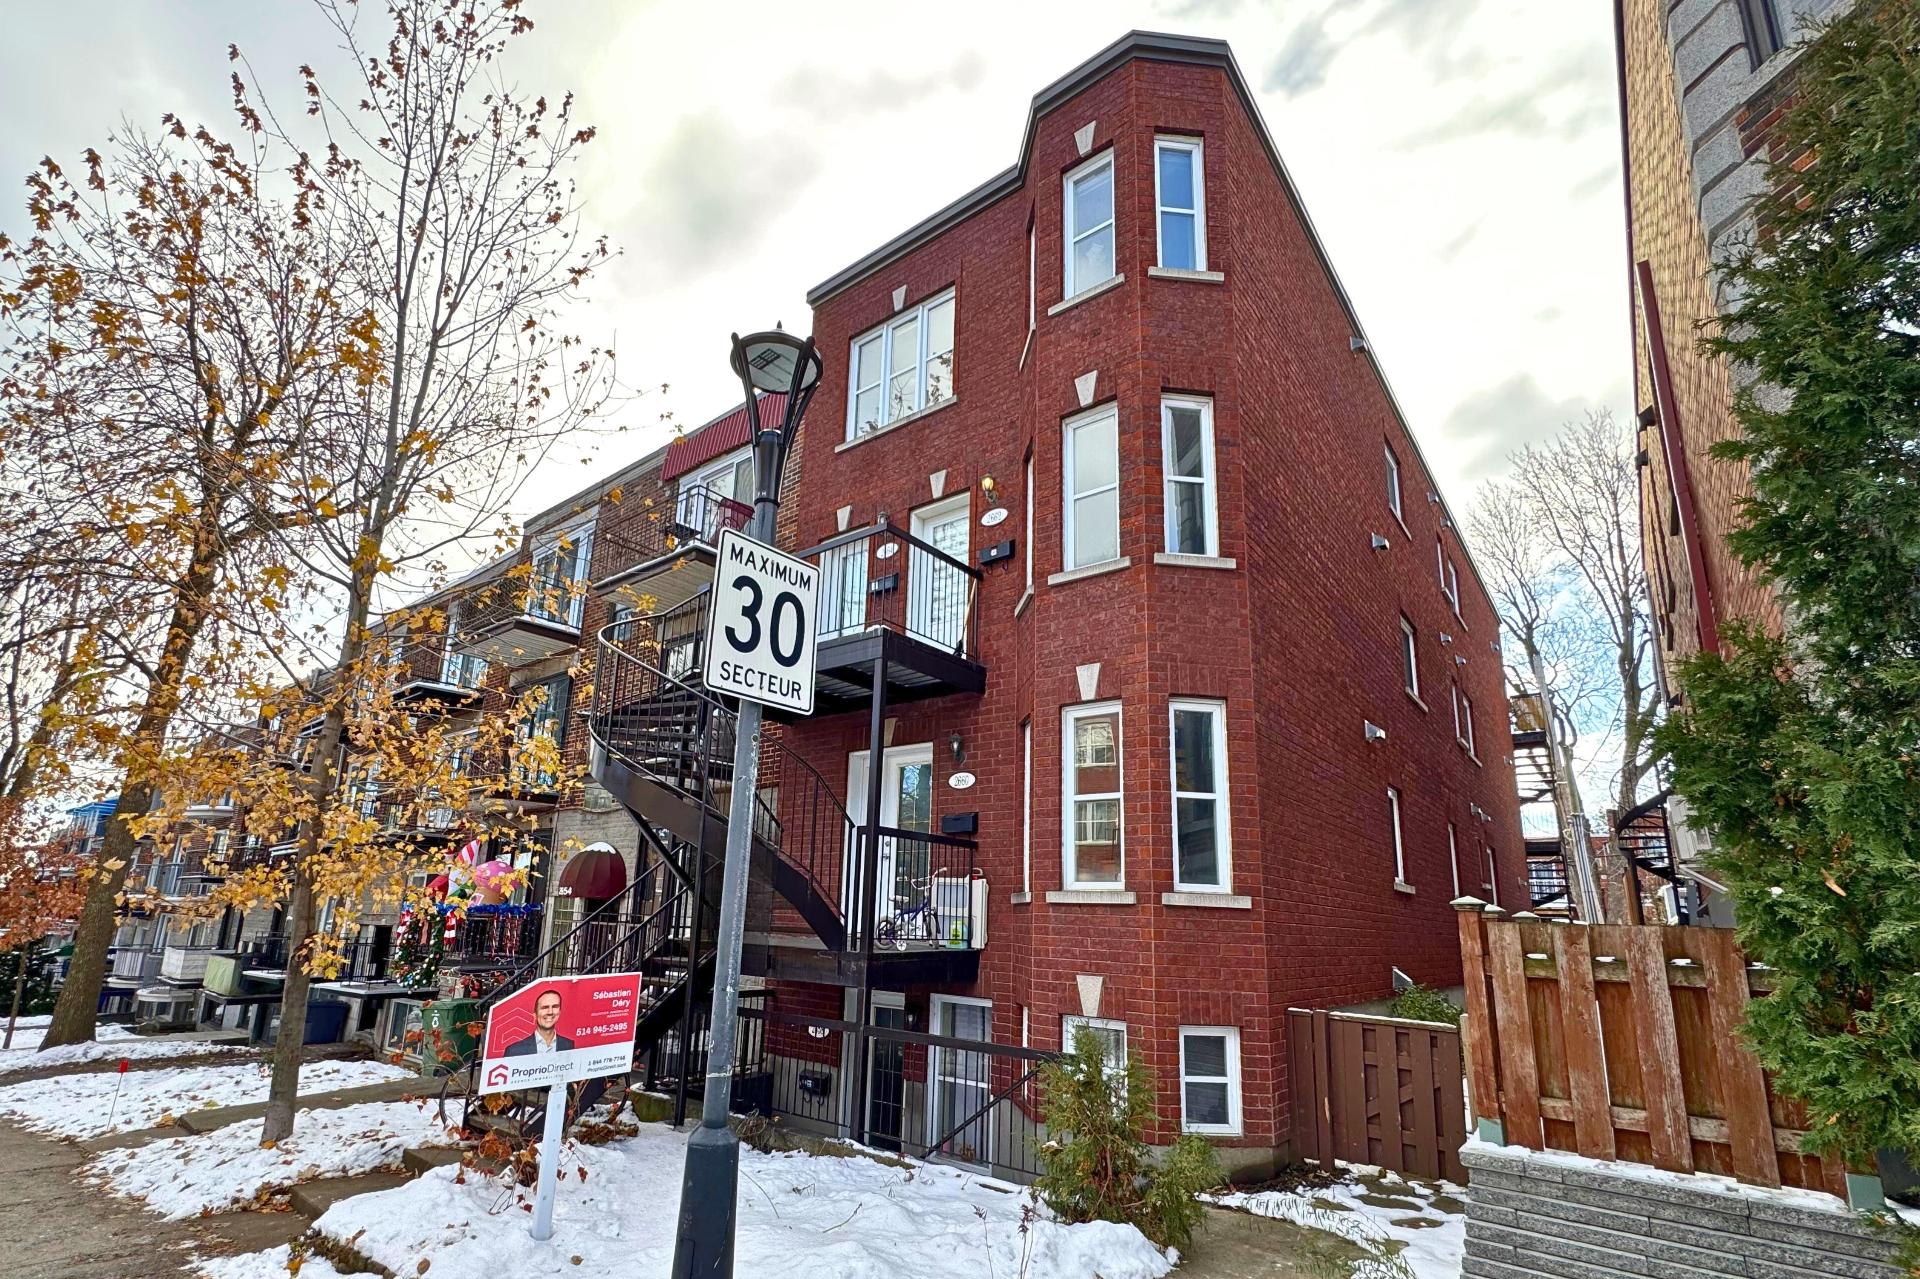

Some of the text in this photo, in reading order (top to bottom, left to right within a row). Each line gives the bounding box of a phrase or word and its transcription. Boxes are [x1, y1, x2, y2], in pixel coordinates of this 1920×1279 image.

[730, 543, 811, 591] MAXIMUM
[724, 575, 806, 668] 30
[720, 660, 802, 701] SECTEUR
[593, 989, 631, 1000] Sébastien
[612, 999, 631, 1008] Déry
[511, 1061, 574, 1078] ProprioDirect
